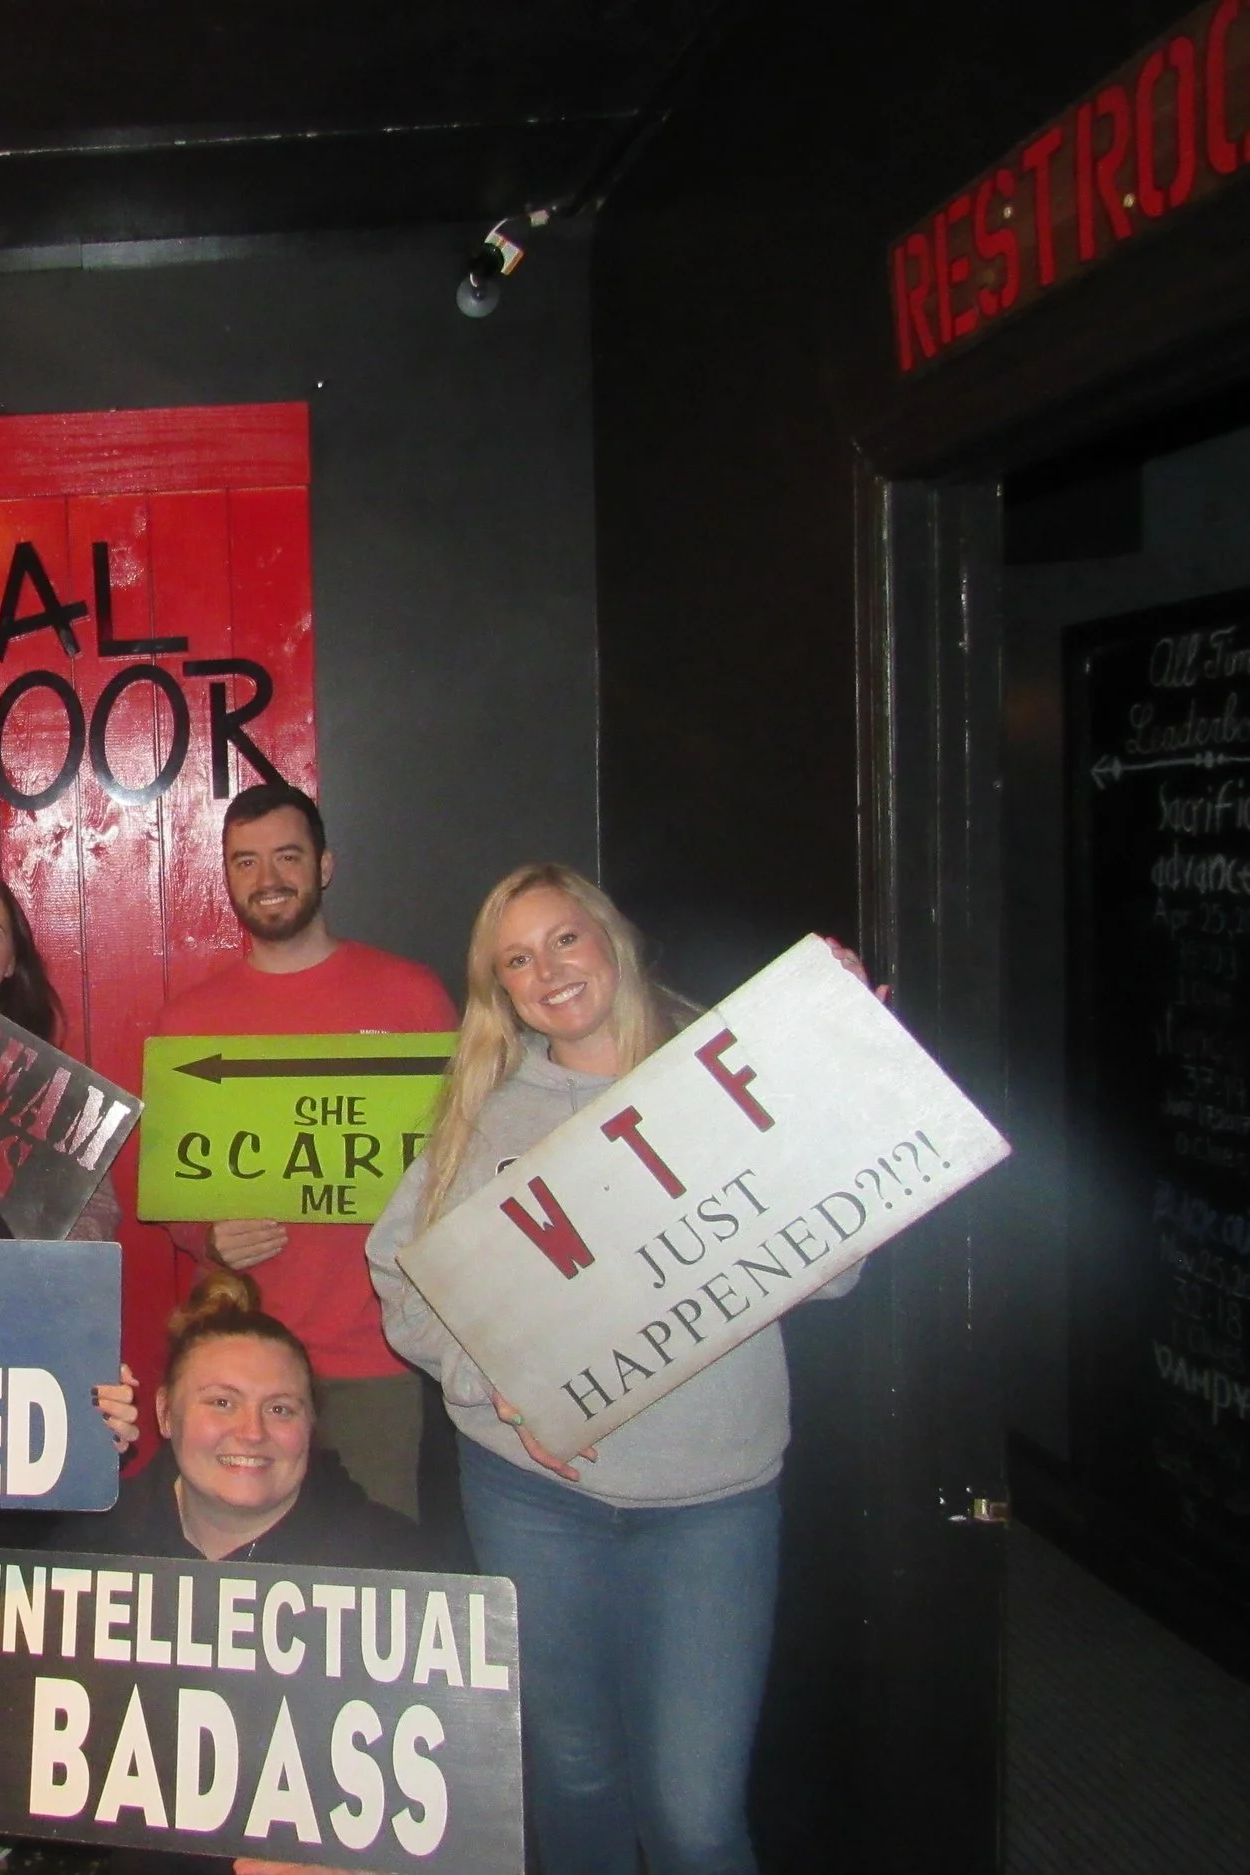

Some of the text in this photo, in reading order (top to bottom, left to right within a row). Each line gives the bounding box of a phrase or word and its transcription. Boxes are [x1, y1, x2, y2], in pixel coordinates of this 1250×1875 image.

[294, 1096, 367, 1126] SHE
[301, 1185, 357, 1215] ME
[634, 1168, 771, 1290] JUST
[560, 1129, 953, 1422] HAPPENED?!?!
[29, 1676, 449, 1857] BADASS
